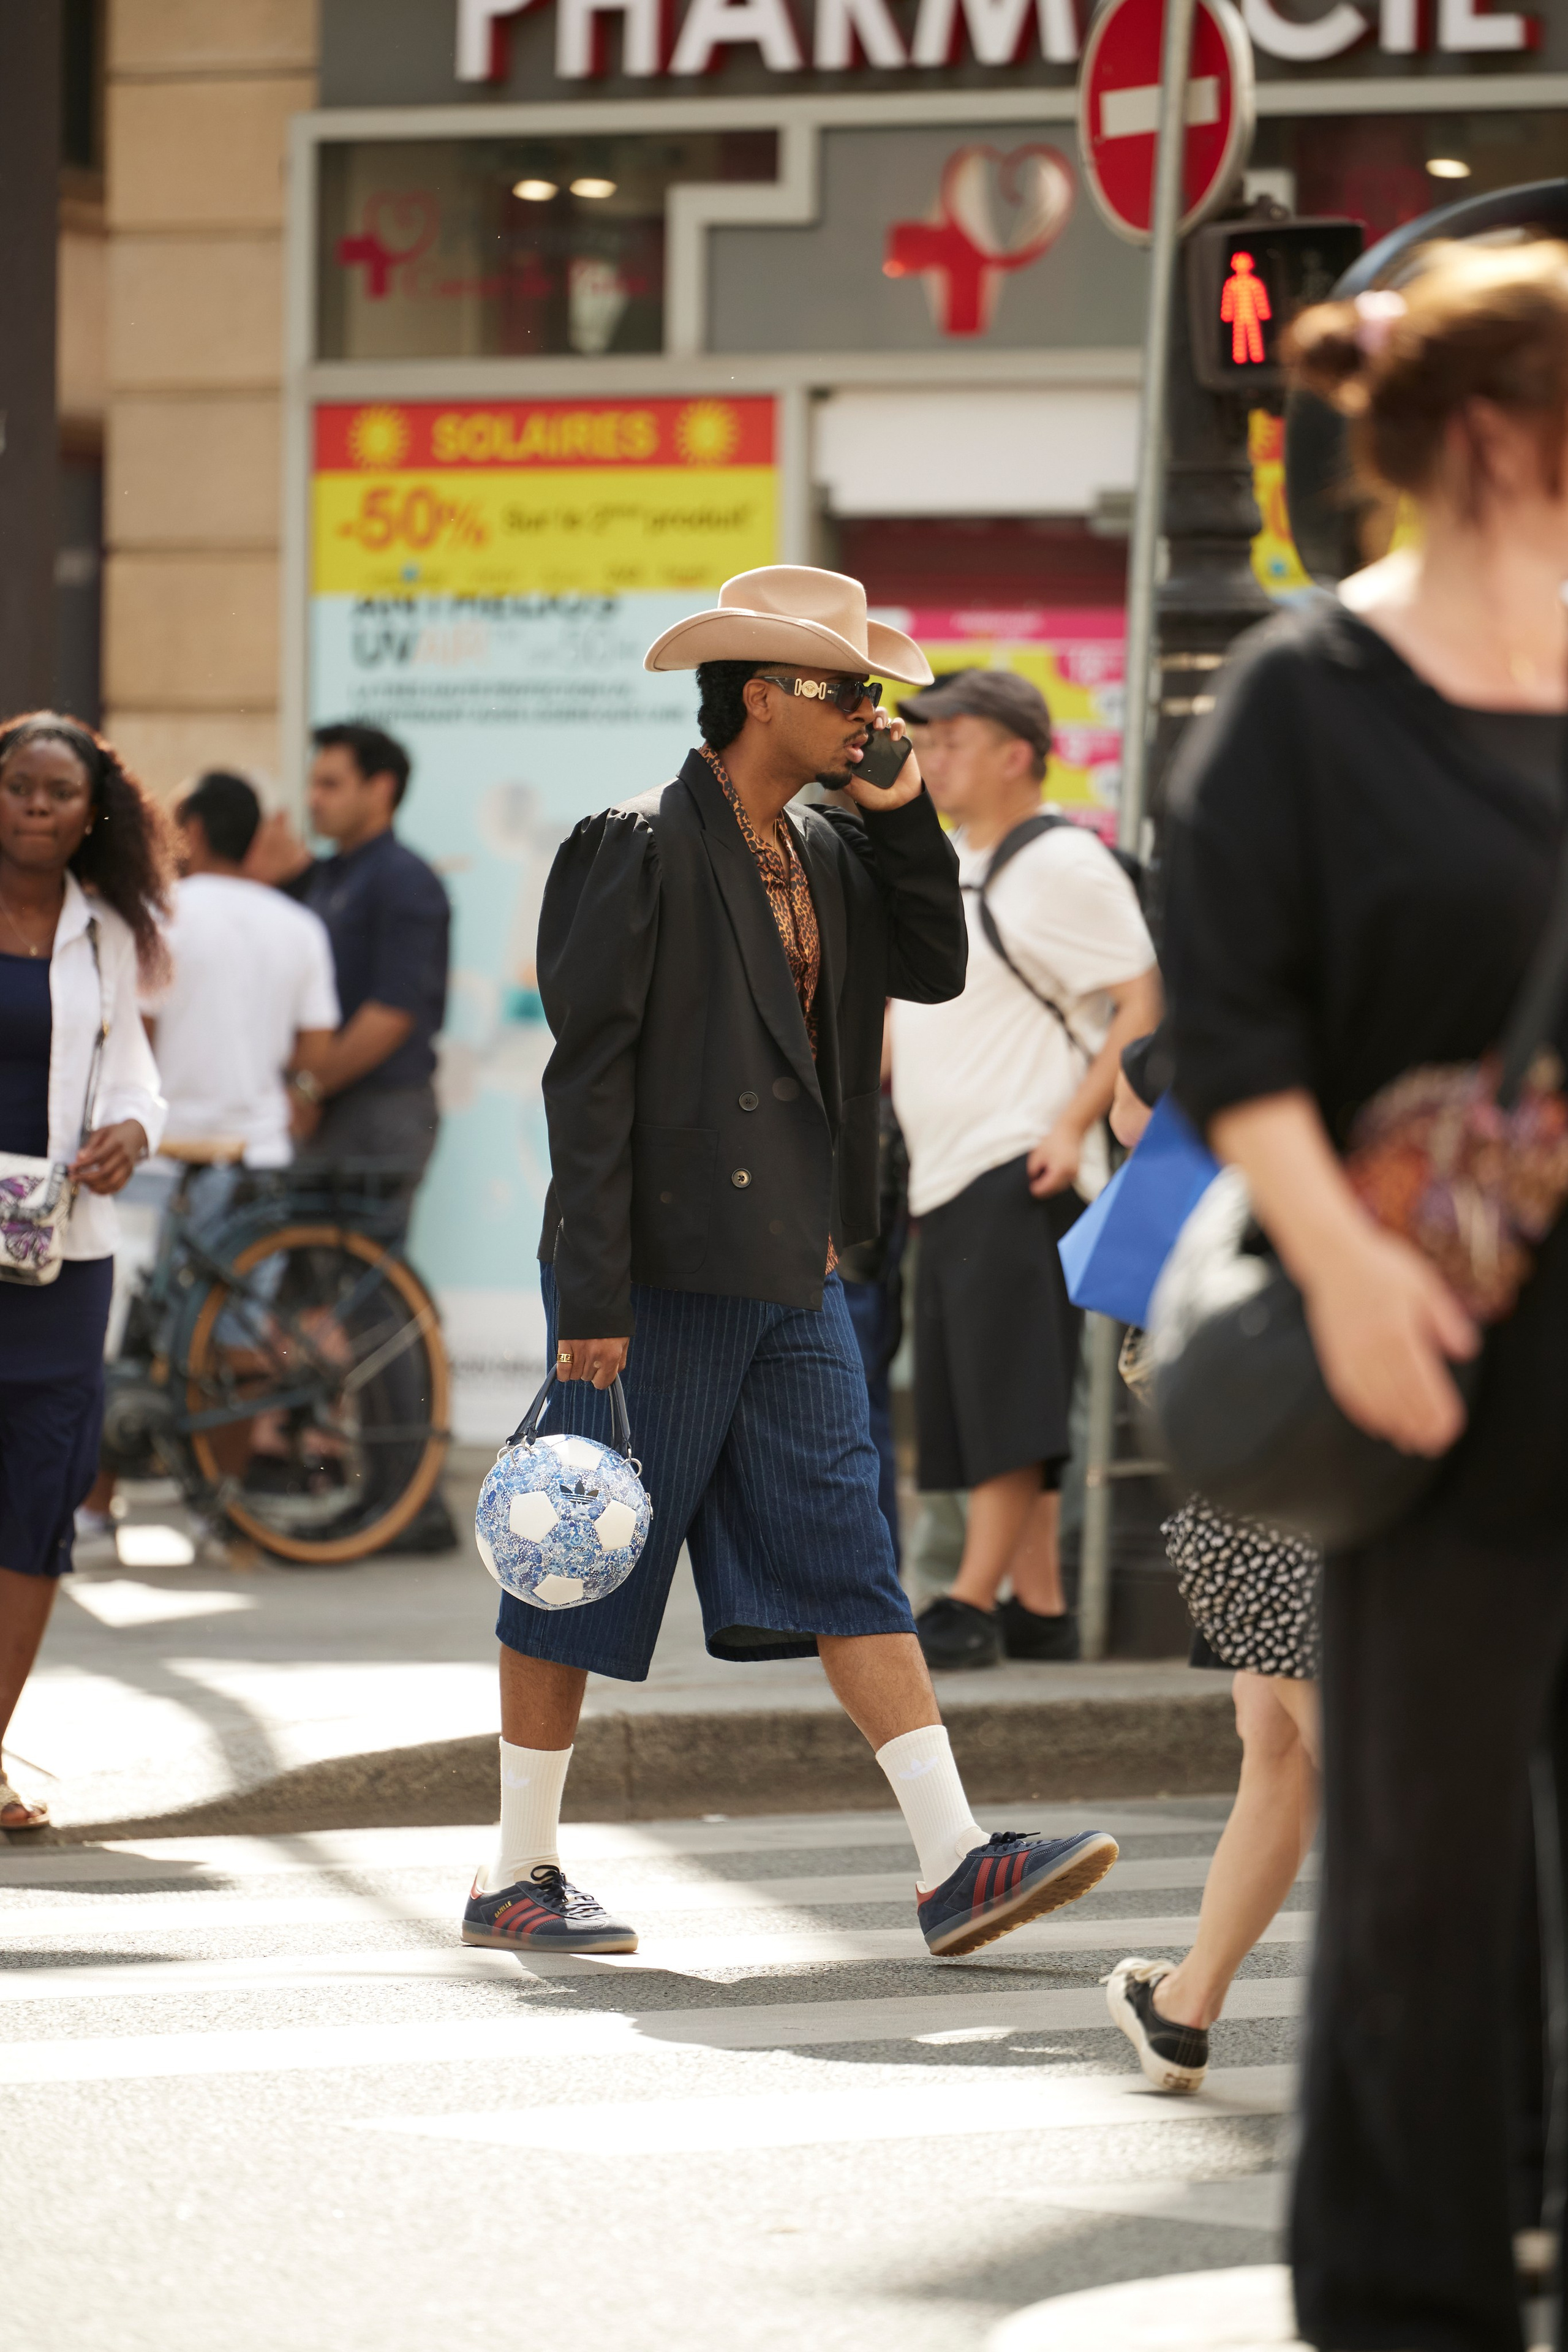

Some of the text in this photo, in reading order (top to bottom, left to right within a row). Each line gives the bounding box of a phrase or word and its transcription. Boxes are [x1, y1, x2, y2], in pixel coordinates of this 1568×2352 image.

[454, 0, 1531, 81] PHARMCI
[431, 410, 660, 462] SOLAIRES
[338, 486, 490, 550] -50%
[494, 1901, 512, 1918] GAZELLE
